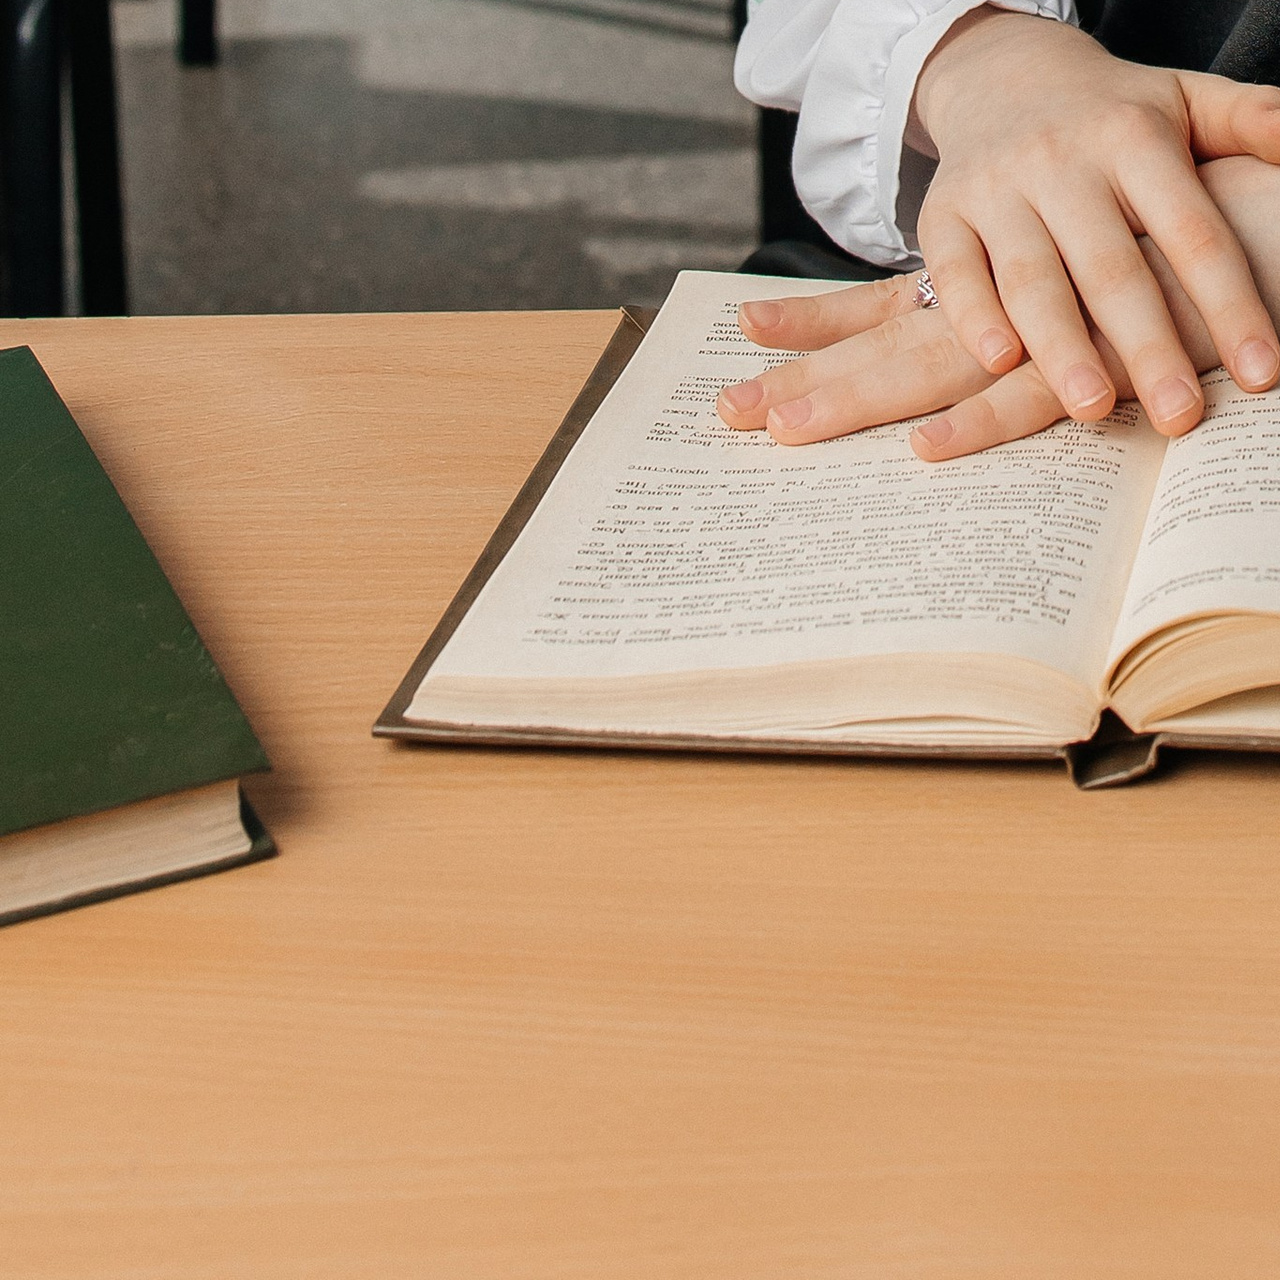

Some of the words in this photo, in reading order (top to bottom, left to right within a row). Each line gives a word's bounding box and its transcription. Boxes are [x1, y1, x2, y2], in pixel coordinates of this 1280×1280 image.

[705, 335, 750, 343] оторой
[661, 408, 699, 418] Боже
[689, 431, 738, 439] помогу
